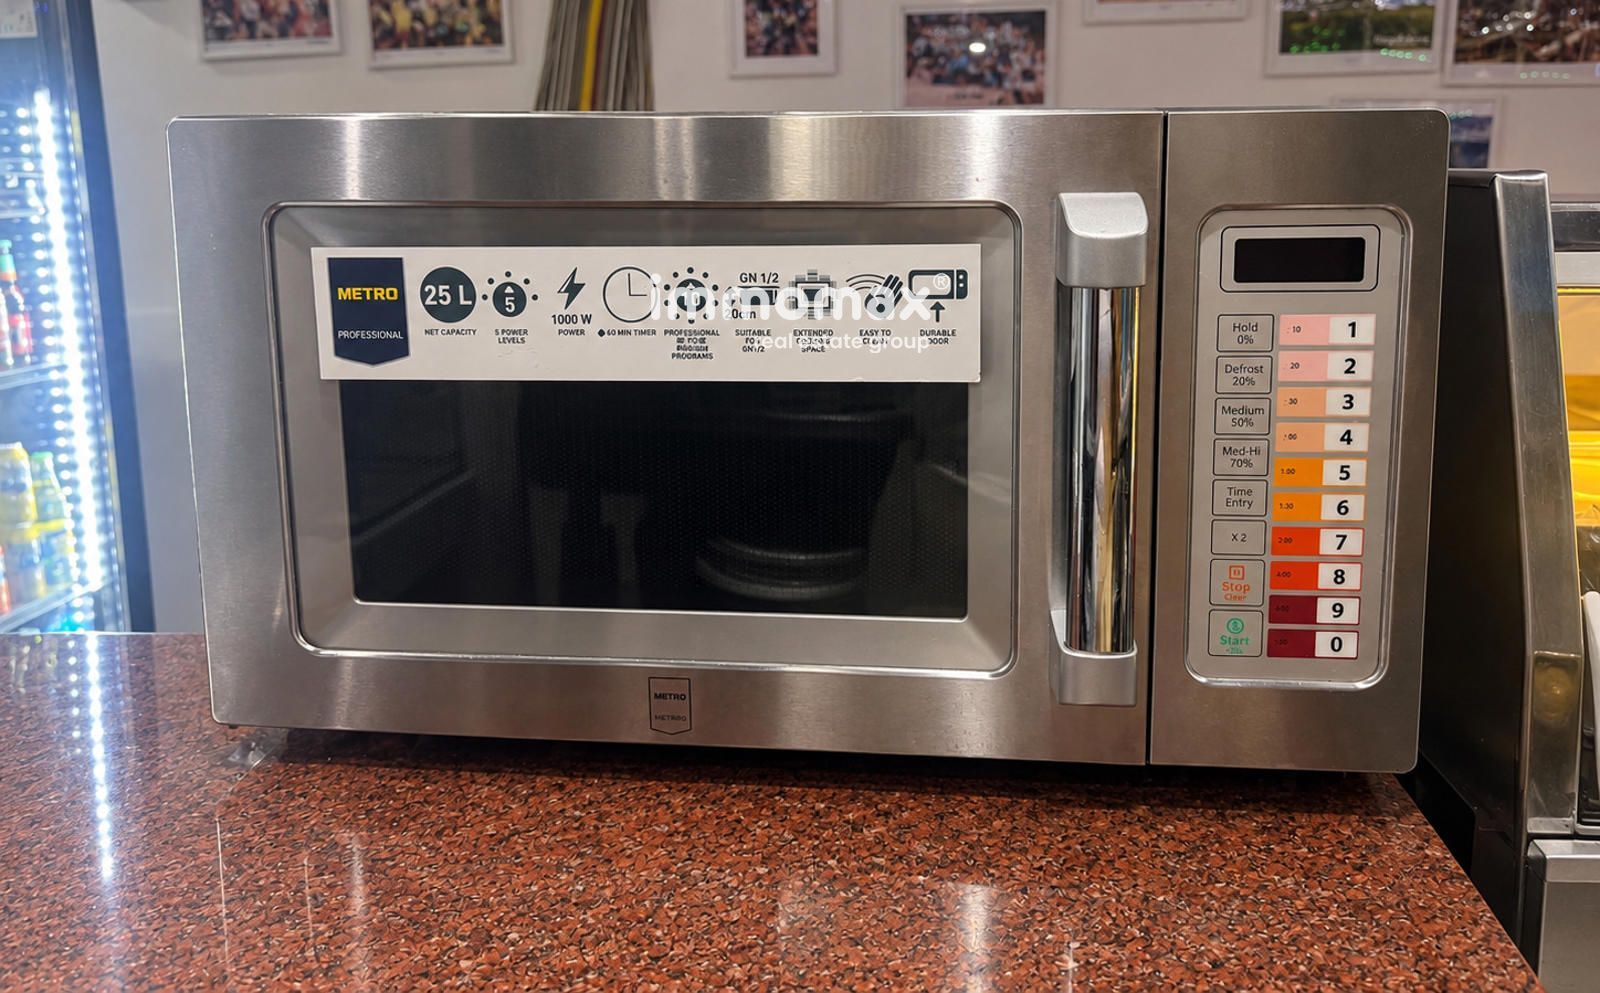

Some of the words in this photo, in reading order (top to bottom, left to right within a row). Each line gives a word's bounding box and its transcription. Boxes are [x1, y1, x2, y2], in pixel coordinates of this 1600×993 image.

[740, 273, 757, 284] GN
[761, 272, 779, 284] 1/2
[337, 287, 399, 301] METRO
[424, 285, 451, 306] 25
[459, 285, 473, 306] L
[504, 297, 516, 313] 5
[552, 314, 578, 325] 1000
[580, 314, 592, 325] W
[664, 329, 720, 337] PROFESSIONAL
[735, 329, 772, 337] SUITABLE
[793, 329, 834, 337] EXTENDED
[859, 329, 879, 337] EASY
[881, 329, 892, 337] TO
[920, 329, 957, 337] DURABLE
[1232, 322, 1258, 333] Hold
[1348, 322, 1357, 338] 1
[338, 329, 404, 340] PROFESSIONAL
[1237, 335, 1254, 344] 0%
[498, 337, 526, 345] LEVELS
[1224, 364, 1264, 374] Defrost
[1344, 358, 1356, 374] 2
[1232, 376, 1256, 386] 20%
[1342, 394, 1354, 410] 3
[1221, 405, 1264, 415] Medium
[1231, 417, 1254, 427] 50%
[1339, 429, 1353, 445] 4
[1222, 446, 1261, 456] Med-Hi
[1230, 458, 1254, 468] 70%
[1338, 465, 1351, 481] 5
[1227, 487, 1253, 497] Time
[1226, 498, 1254, 509] Entry
[1336, 500, 1349, 516] 6
[1335, 535, 1348, 550] 7
[1333, 569, 1346, 585] 8
[1222, 582, 1250, 594] Stop
[1331, 603, 1344, 618] 9
[1219, 635, 1249, 646] Start
[1330, 637, 1343, 652] 0
[654, 692, 687, 701] METRO
